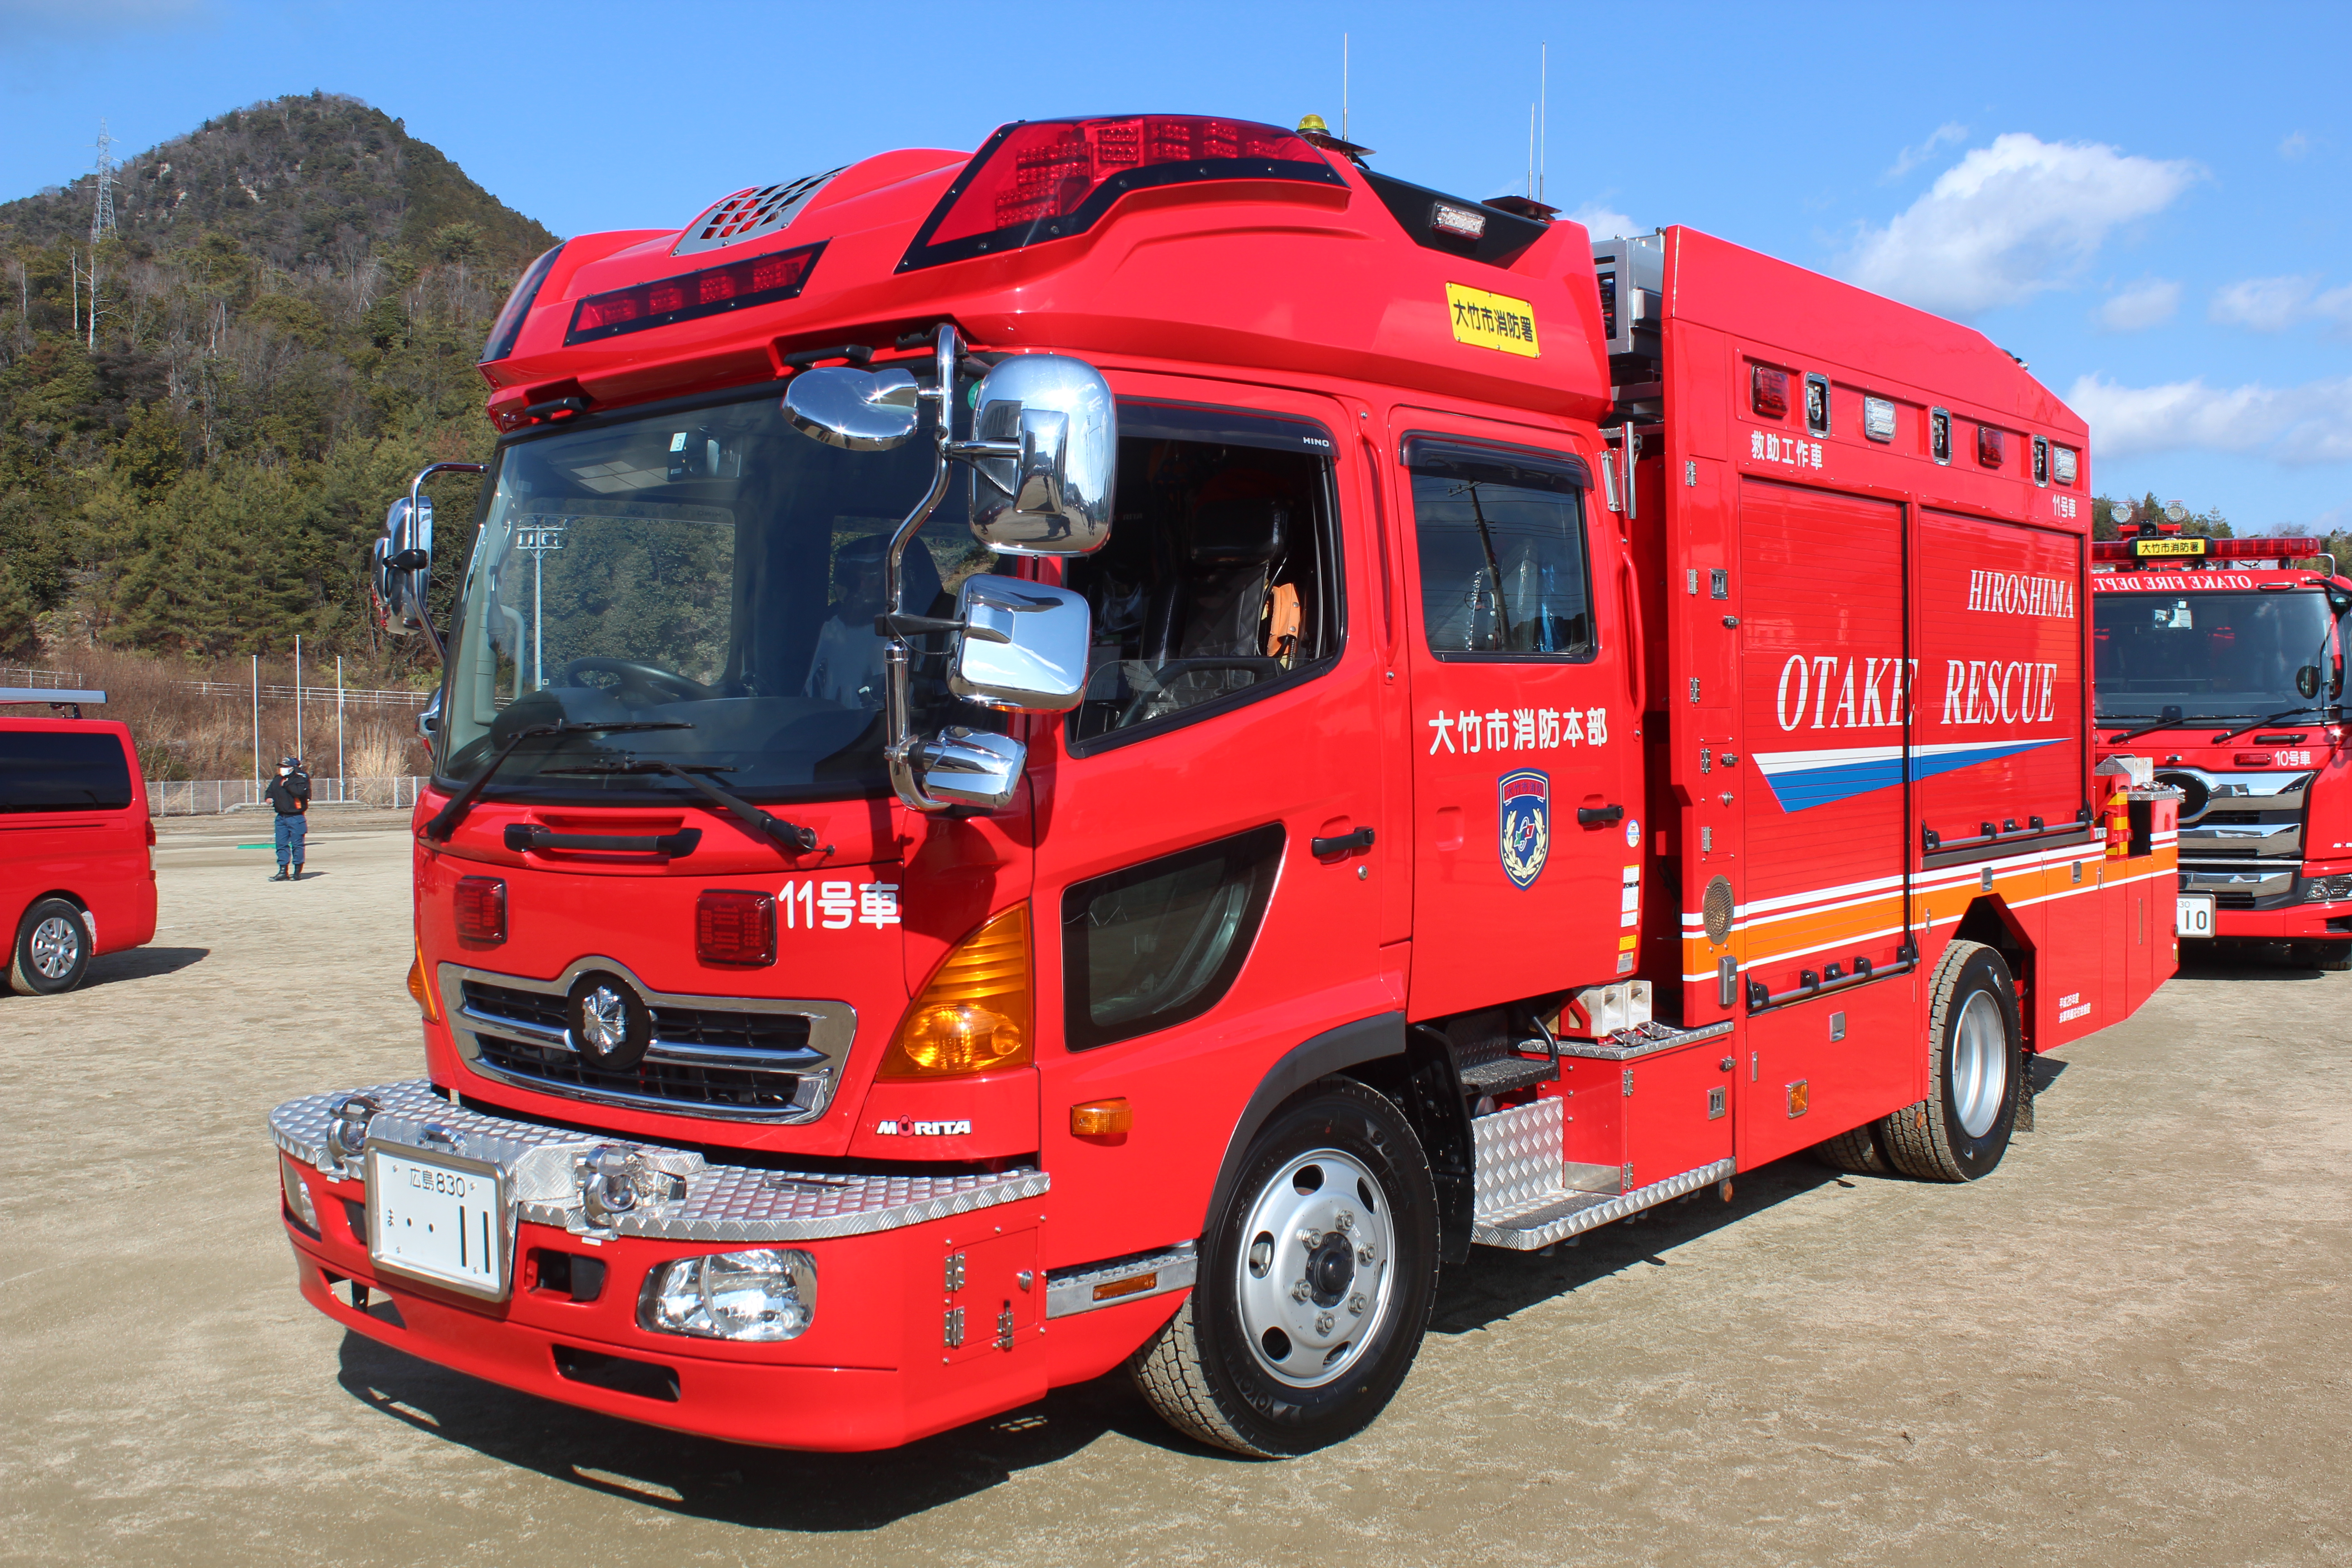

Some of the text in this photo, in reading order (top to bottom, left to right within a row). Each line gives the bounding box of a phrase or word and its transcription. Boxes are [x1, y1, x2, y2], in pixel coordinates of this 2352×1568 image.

[1453, 299, 1534, 343] 大竹市消防署
[1303, 436, 1330, 448] HINO
[1751, 429, 1823, 470] 救助工作車
[1114, 513, 1143, 521] ORITA
[2052, 494, 2077, 519] 11号車
[2141, 542, 2200, 554] 大竹市消防署
[1967, 568, 2074, 619] HIROSHIMA
[1777, 654, 2058, 731] OTAKE RESCUE
[1429, 706, 1607, 755] 大竹市消防本部
[2274, 750, 2311, 766] 10号車
[1506, 781, 1543, 798] 大竹市消防
[778, 880, 901, 930] 11号車
[2185, 910, 2207, 930] 10
[876, 1114, 972, 1138] MORITA
